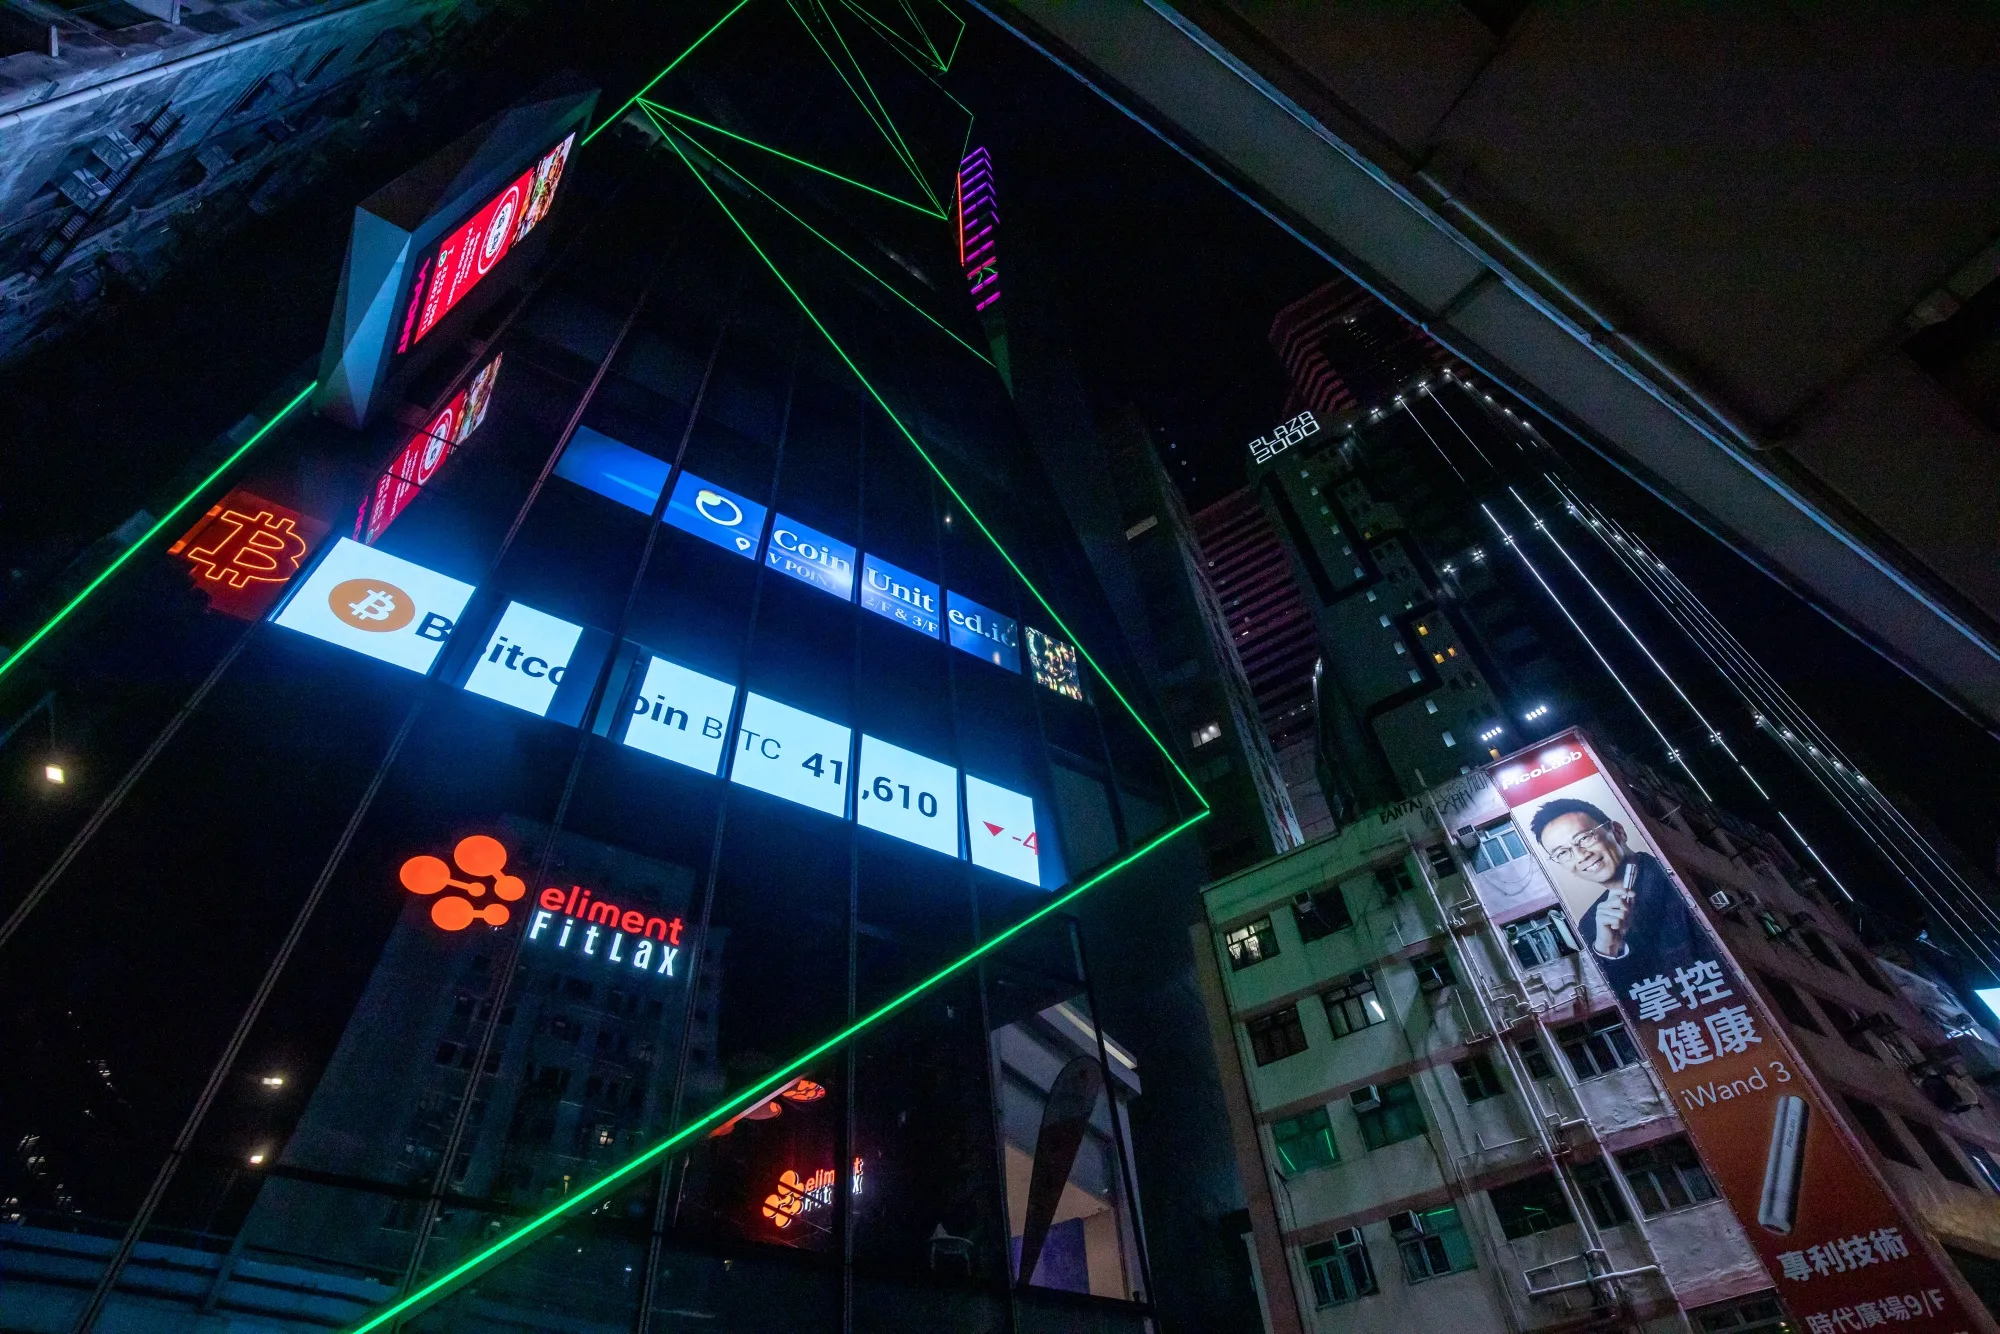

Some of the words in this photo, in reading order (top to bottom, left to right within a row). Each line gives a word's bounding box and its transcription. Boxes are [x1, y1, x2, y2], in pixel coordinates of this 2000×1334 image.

[1248, 411, 1315, 455] PLAZA
[1255, 420, 1321, 464] 2000
[539, 886, 683, 946] eliment
[1628, 960, 1734, 1022] 掌控
[1657, 1004, 1762, 1073] 健康
[1681, 1067, 1768, 1111] iWand
[1769, 1061, 1792, 1083] 3
[1776, 1227, 1910, 1283] 專利技術
